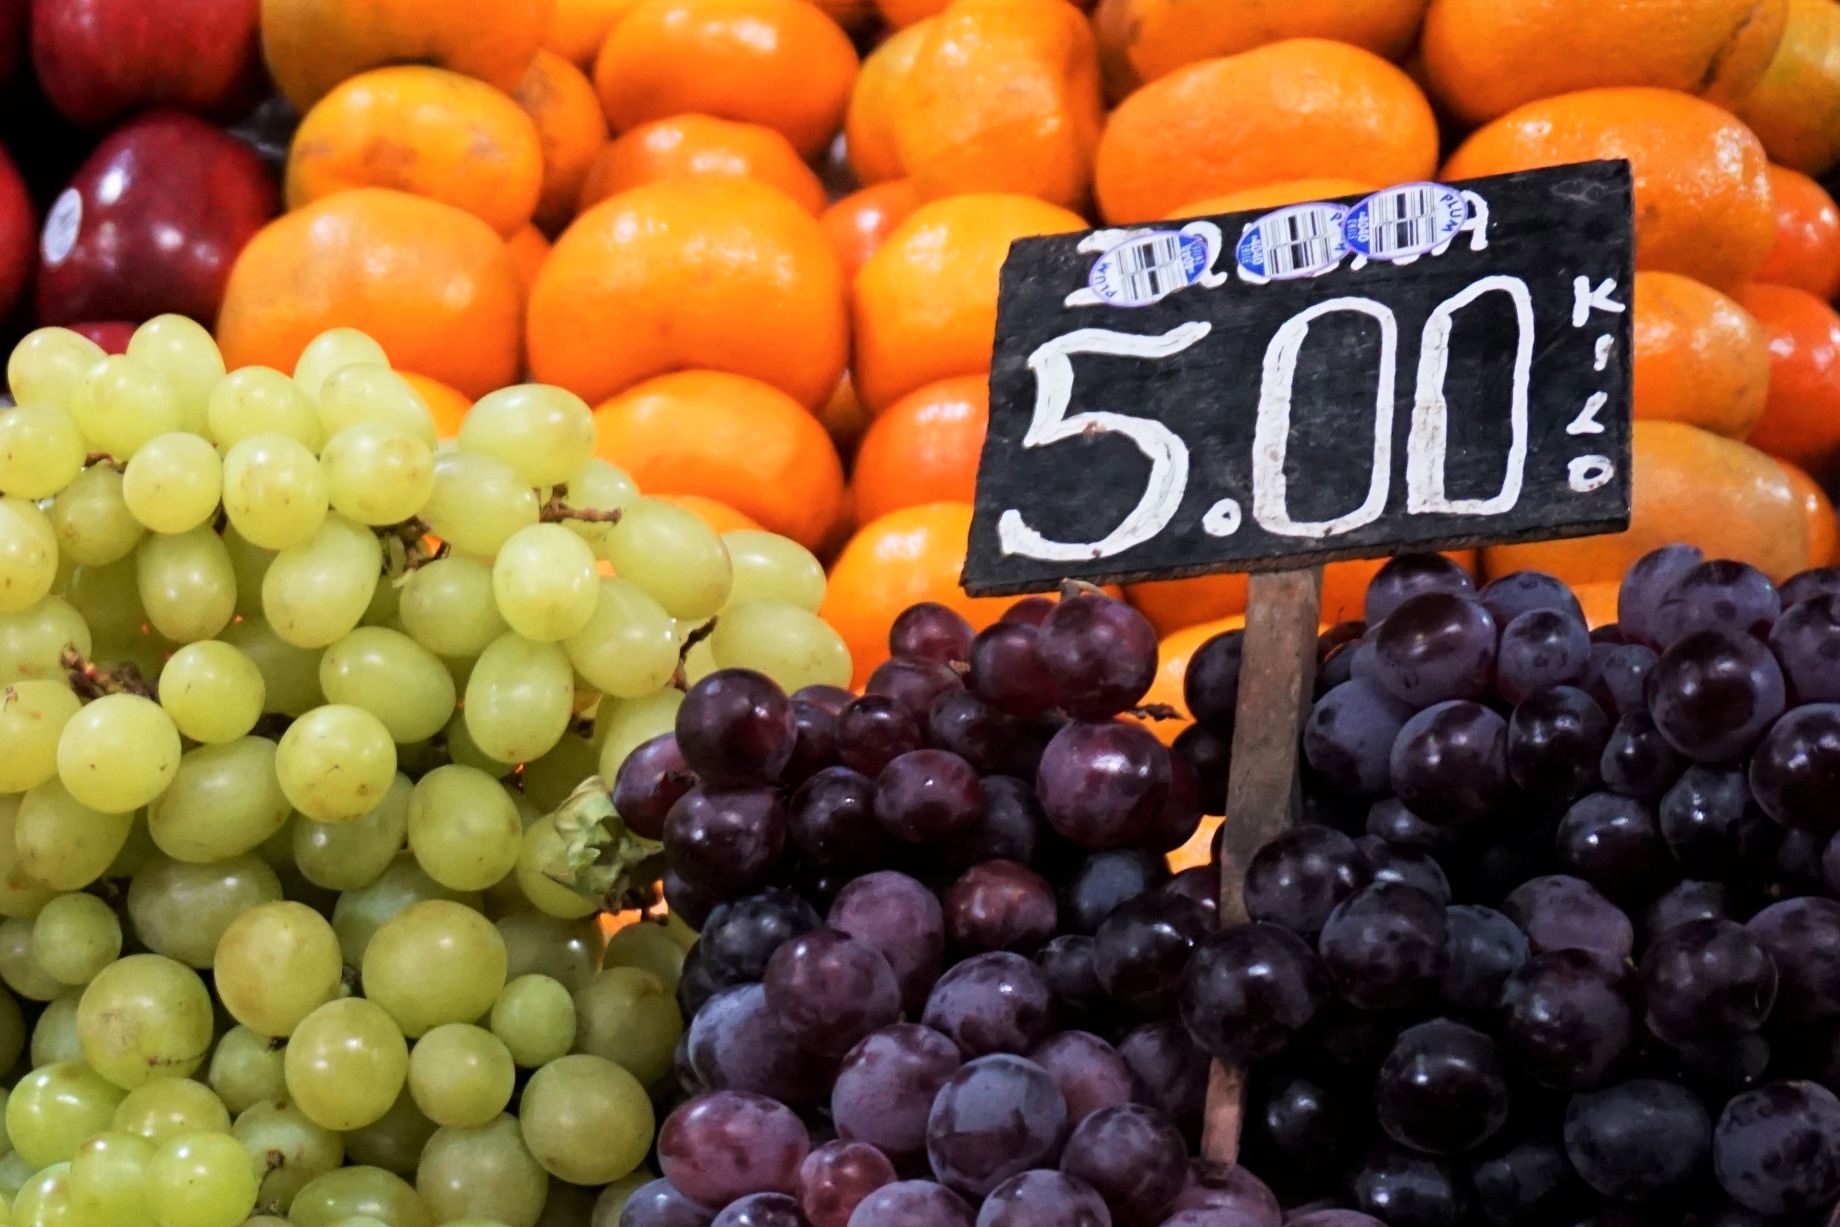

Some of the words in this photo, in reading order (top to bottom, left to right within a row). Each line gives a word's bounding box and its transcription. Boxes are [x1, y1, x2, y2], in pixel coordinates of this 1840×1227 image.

[1440, 193, 1463, 232] PLUM
[1095, 262, 1118, 298] PLUM
[997, 275, 1534, 560] 5.00
